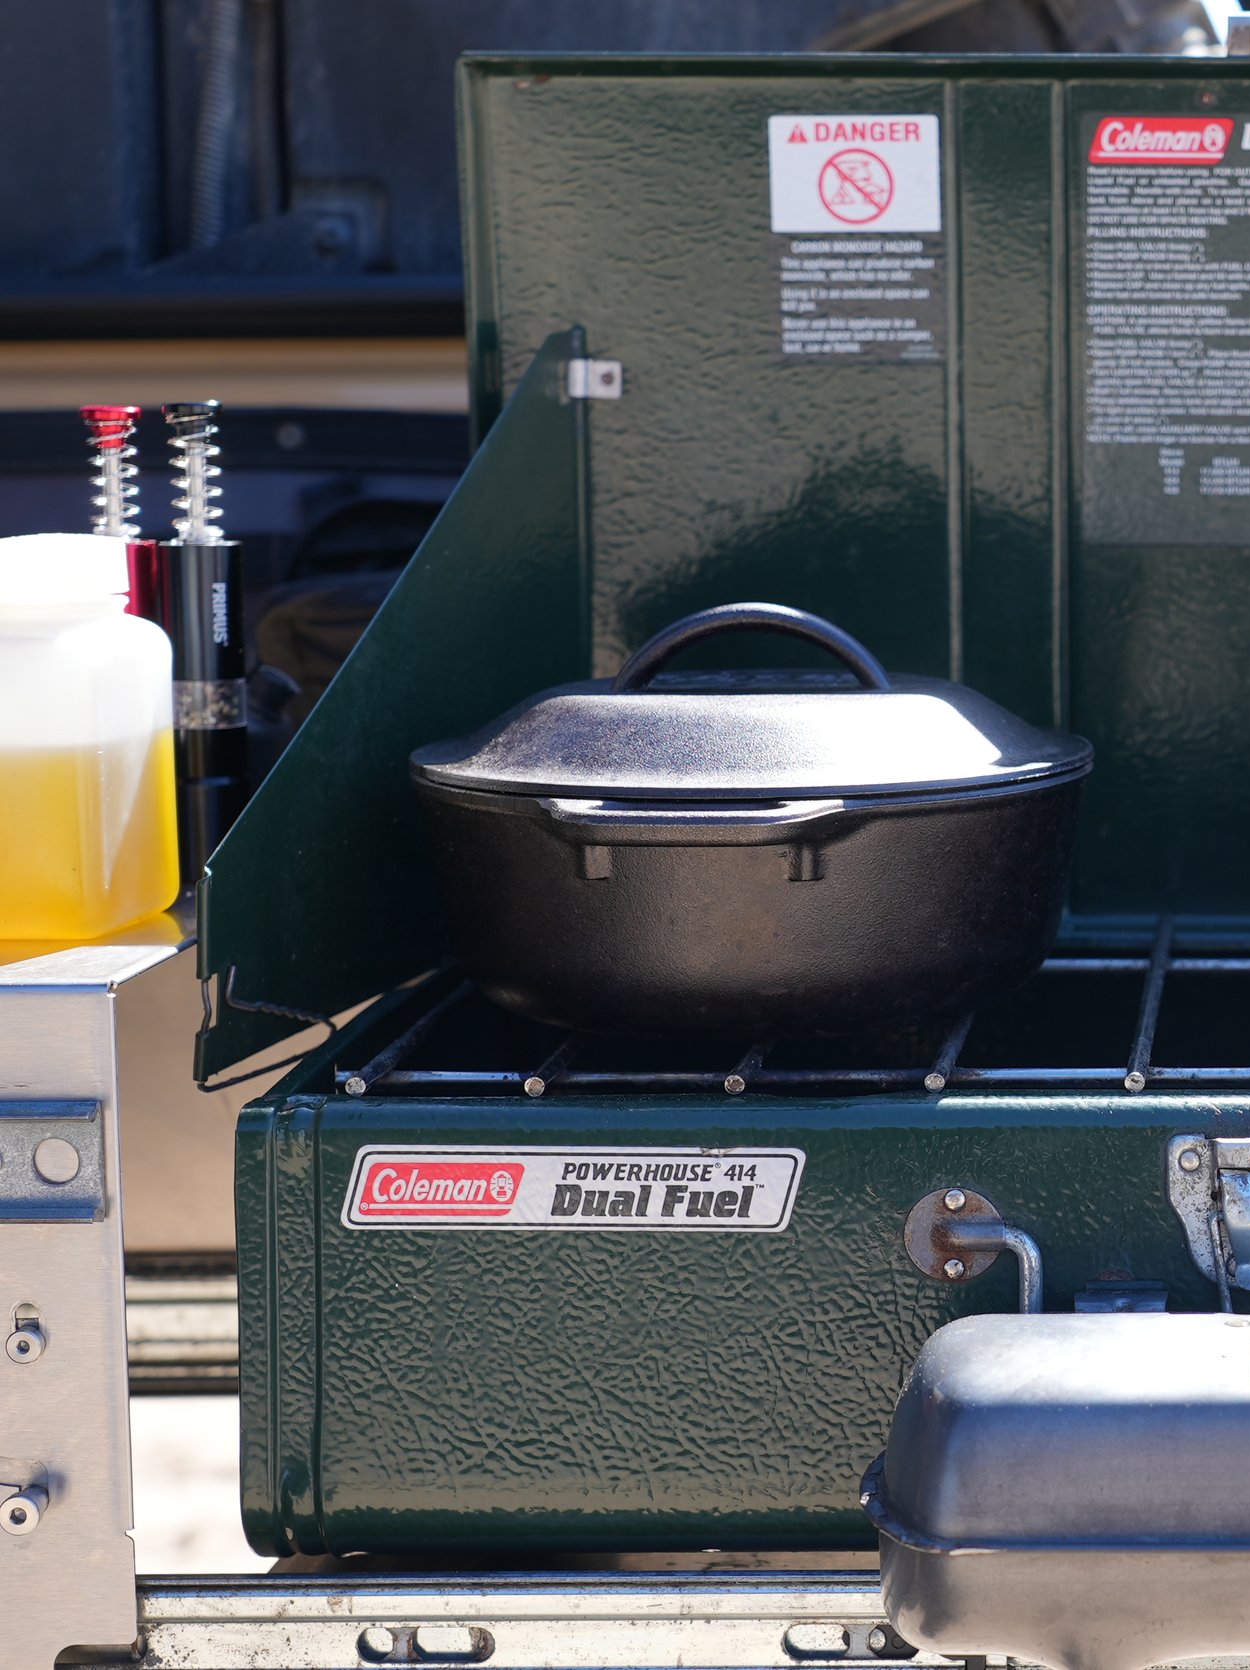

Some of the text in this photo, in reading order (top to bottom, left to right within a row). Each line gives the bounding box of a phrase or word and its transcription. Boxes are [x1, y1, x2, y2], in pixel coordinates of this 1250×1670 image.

[814, 122, 921, 142] DANGER
[1100, 121, 1202, 152] Coleman
[791, 240, 923, 253] CARBON MONOXIDE HAZARD
[371, 1167, 488, 1203] Coleman
[723, 1163, 757, 1182] 414
[551, 1183, 652, 1218] Dual
